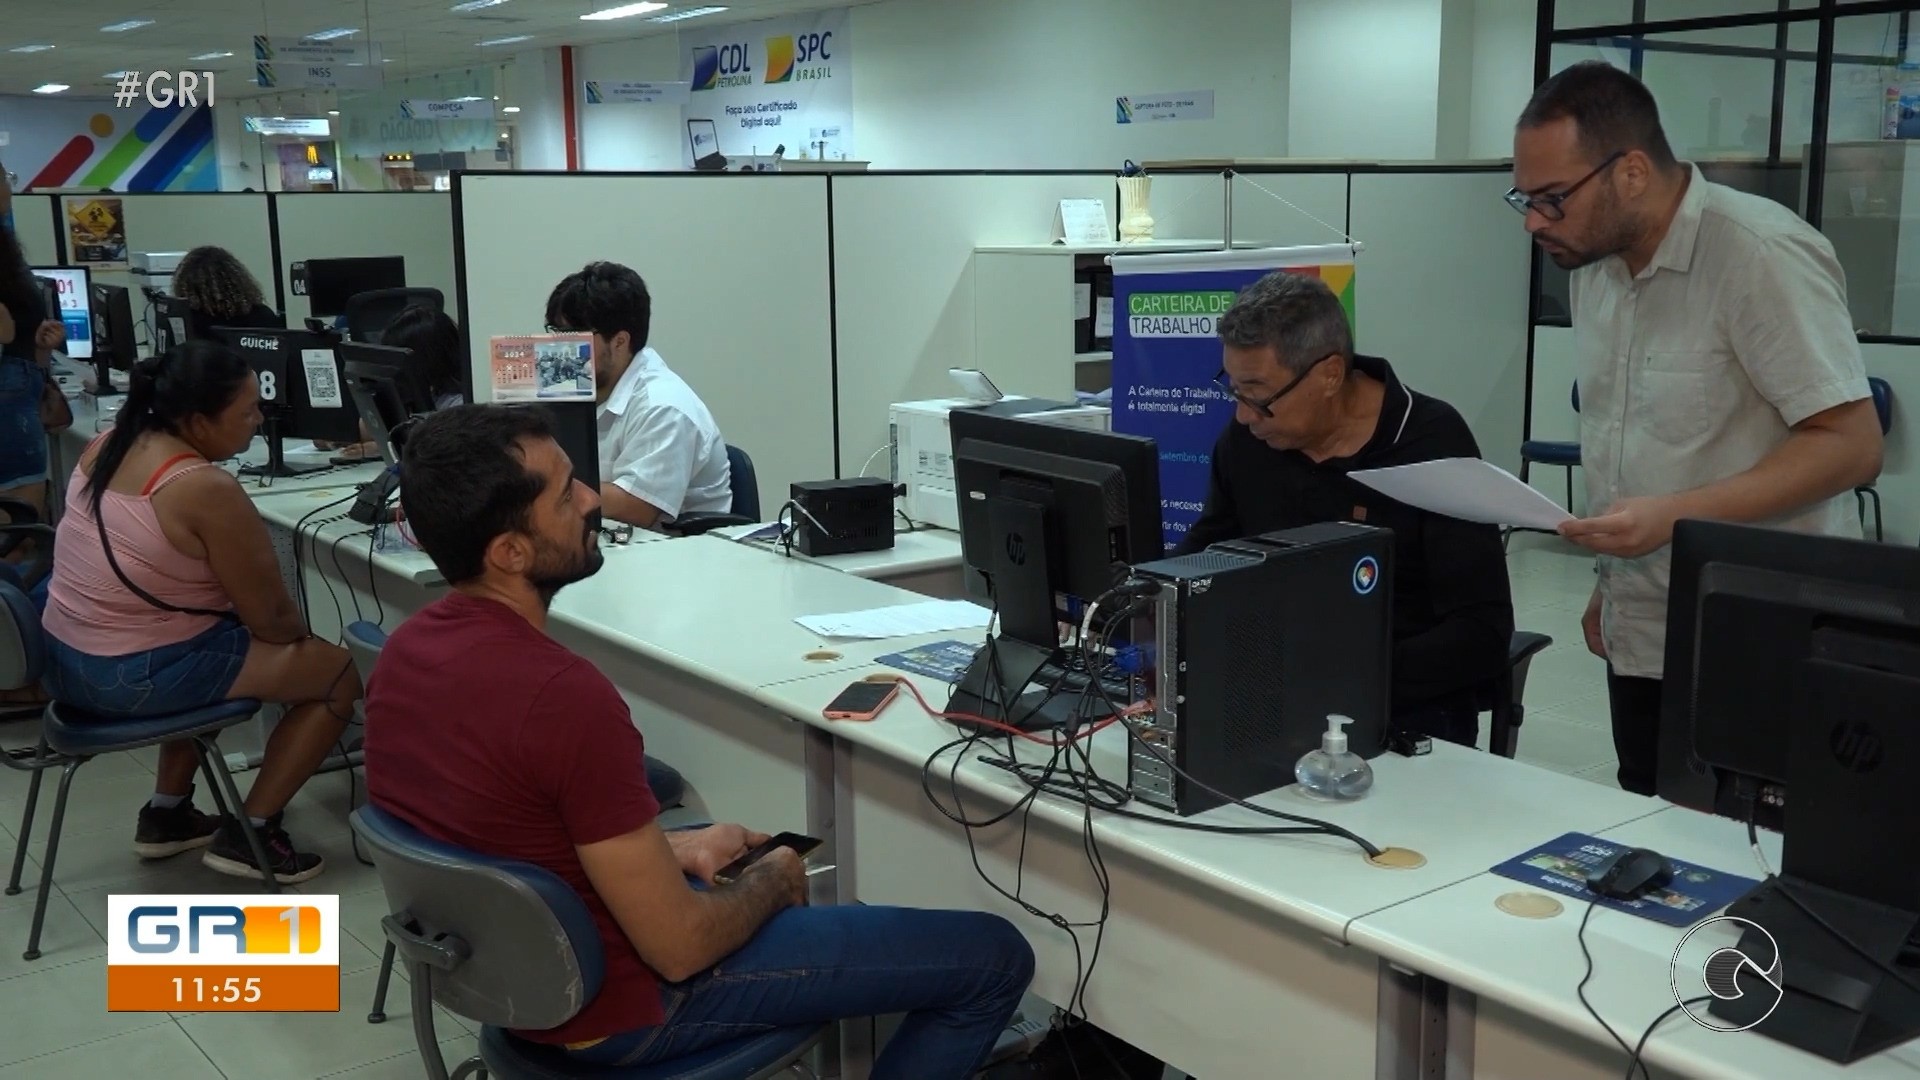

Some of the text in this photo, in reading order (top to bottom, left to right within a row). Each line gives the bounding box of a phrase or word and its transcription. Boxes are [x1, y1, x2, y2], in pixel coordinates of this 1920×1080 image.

[797, 31, 832, 63] SPC
[719, 42, 751, 75] CDL
[308, 67, 332, 78] INSS
[796, 67, 832, 81] BRASIL
[717, 75, 752, 88] PETROLINA
[428, 102, 464, 112] COMPESA
[725, 100, 798, 117] Faça seu Certificado
[740, 117, 763, 129] Digital
[1131, 295, 1231, 314] CARTEIRA DE
[1132, 317, 1212, 334] TRABALHO
[253, 369, 277, 400] 8
[1128, 385, 1137, 396] A
[1138, 385, 1170, 398] Carteira
[1171, 387, 1182, 398] de
[1184, 387, 1221, 400] Trabalho
[1137, 401, 1179, 412] totalmente
[1181, 402, 1206, 416] digital
[1829, 720, 1882, 773] hp
